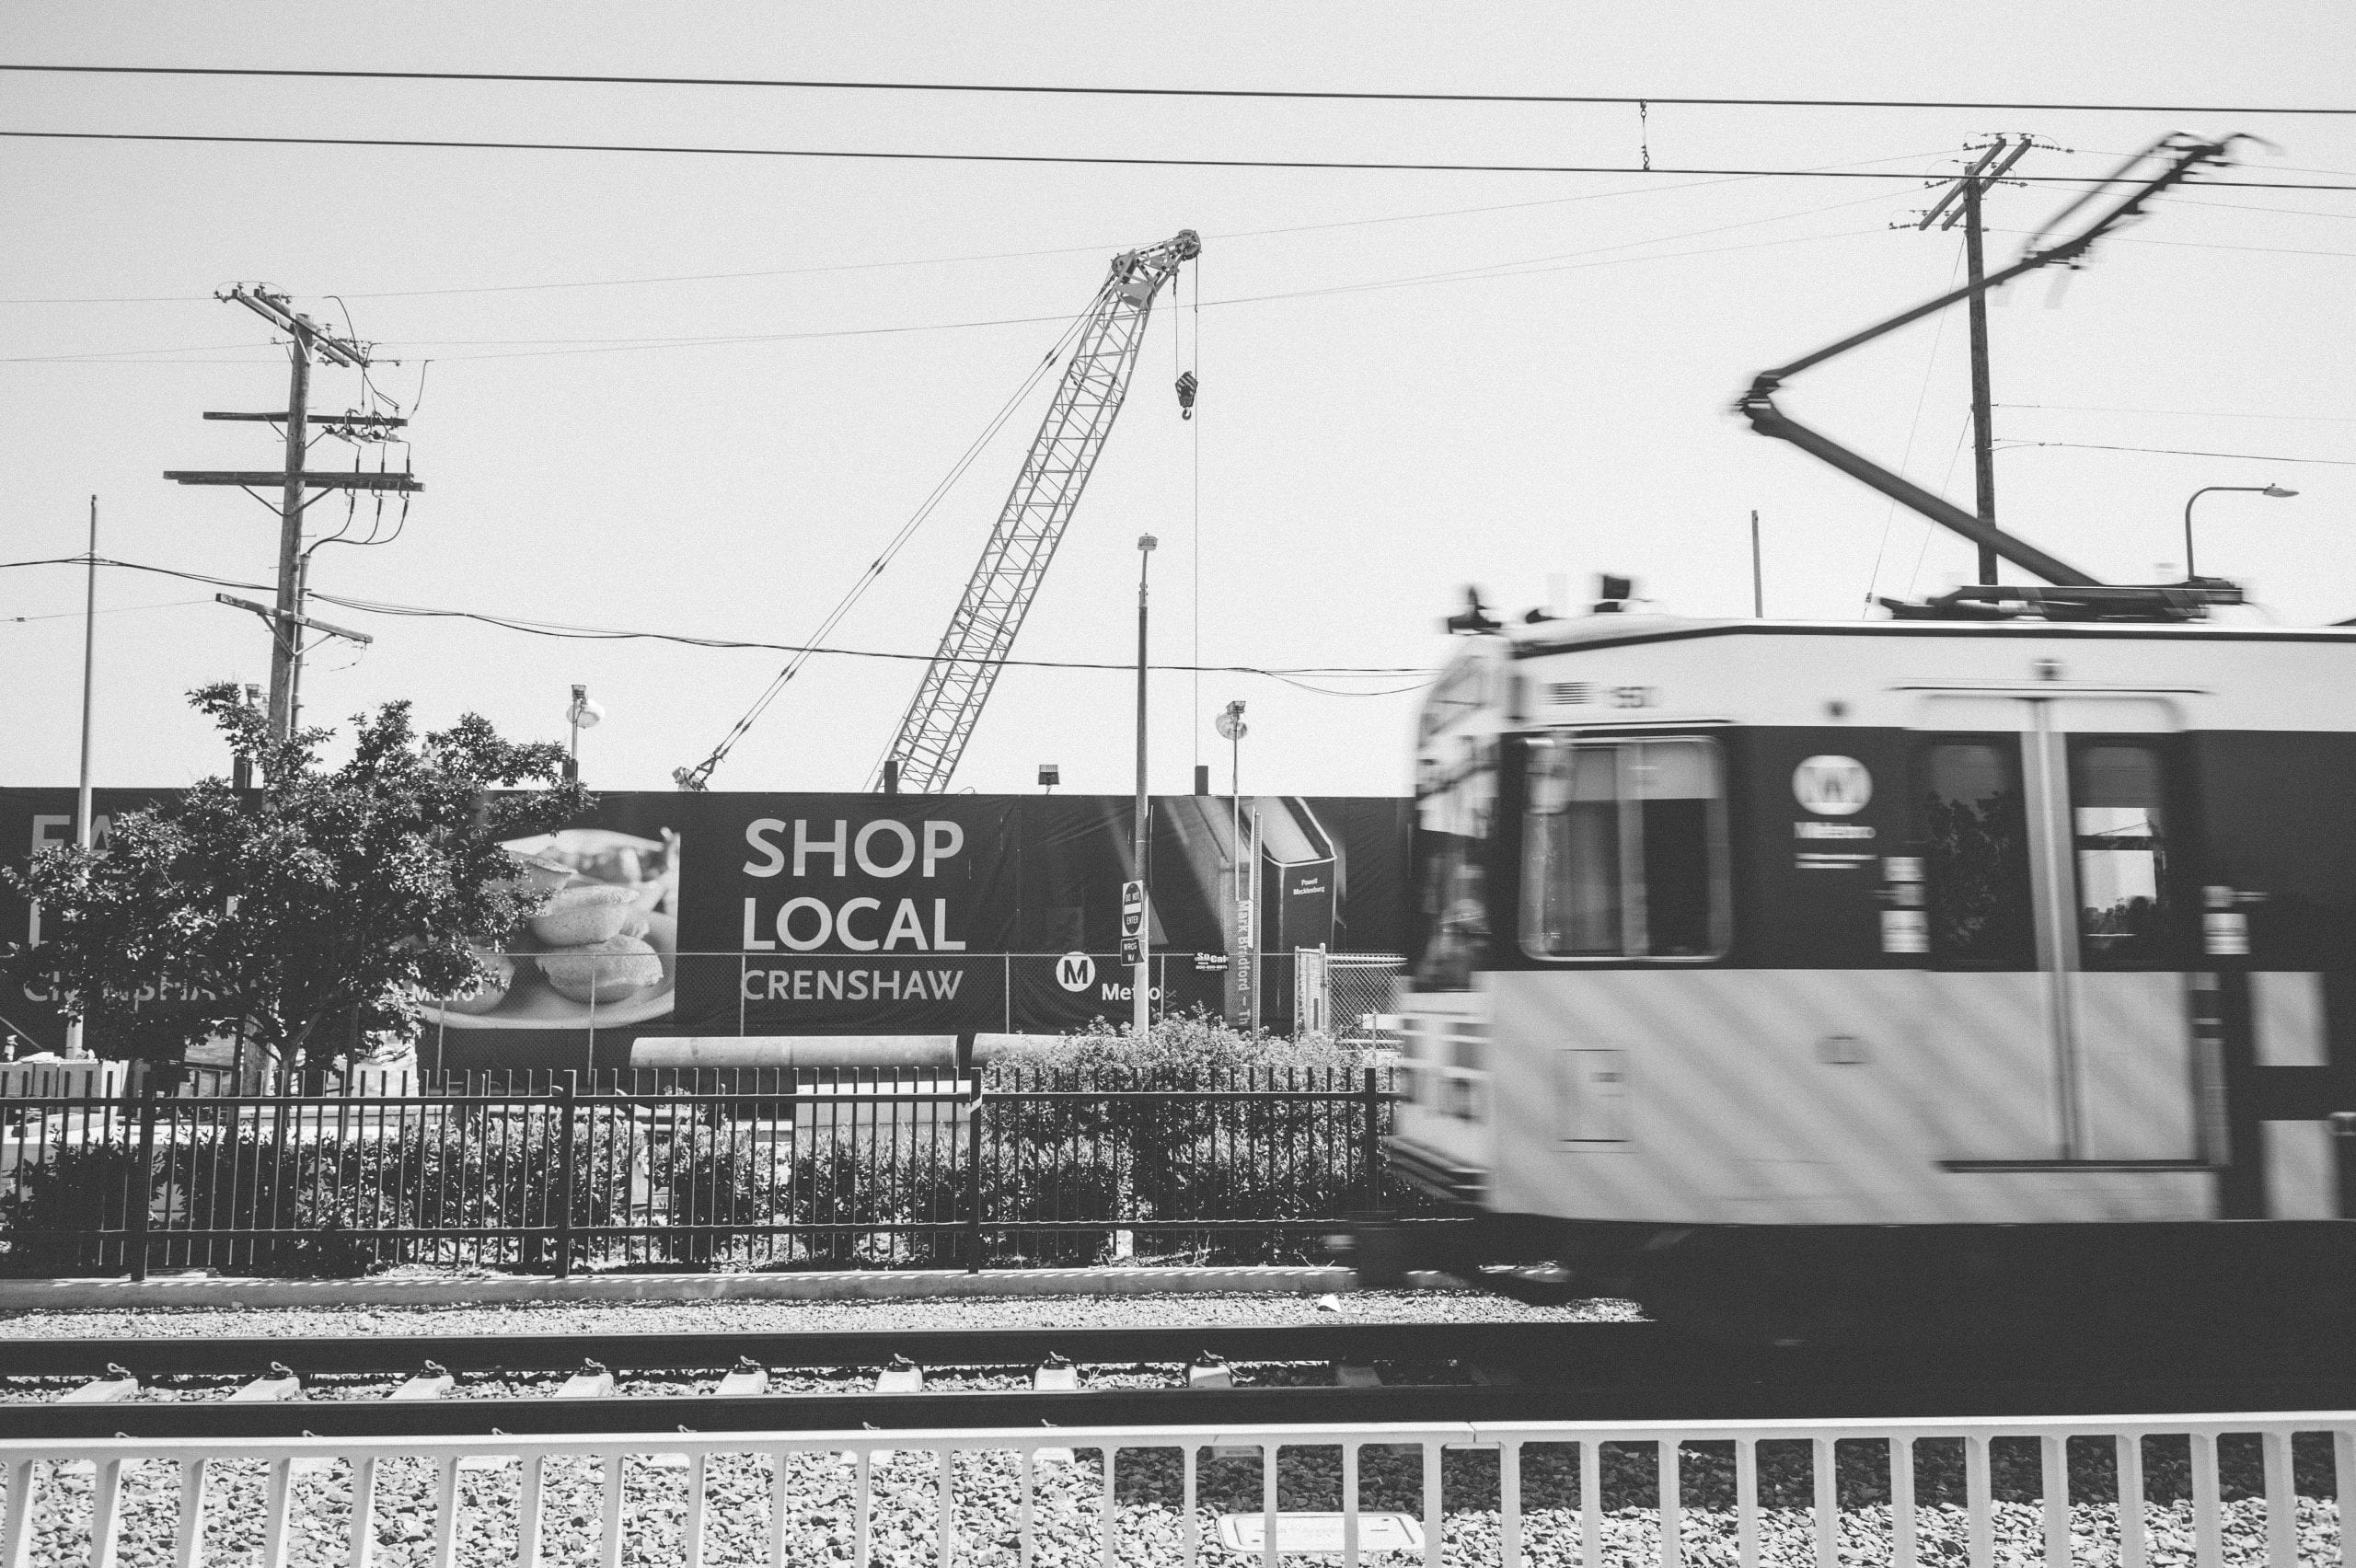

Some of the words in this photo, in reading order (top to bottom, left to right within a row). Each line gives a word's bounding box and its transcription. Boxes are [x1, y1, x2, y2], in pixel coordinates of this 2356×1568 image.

[743, 818, 964, 878] SHOP
[743, 896, 966, 951] LOCAL
[1126, 915, 1139, 925] ENTER
[741, 970, 964, 1000] CRENSHAW
[1102, 983, 1161, 1000] Meo
